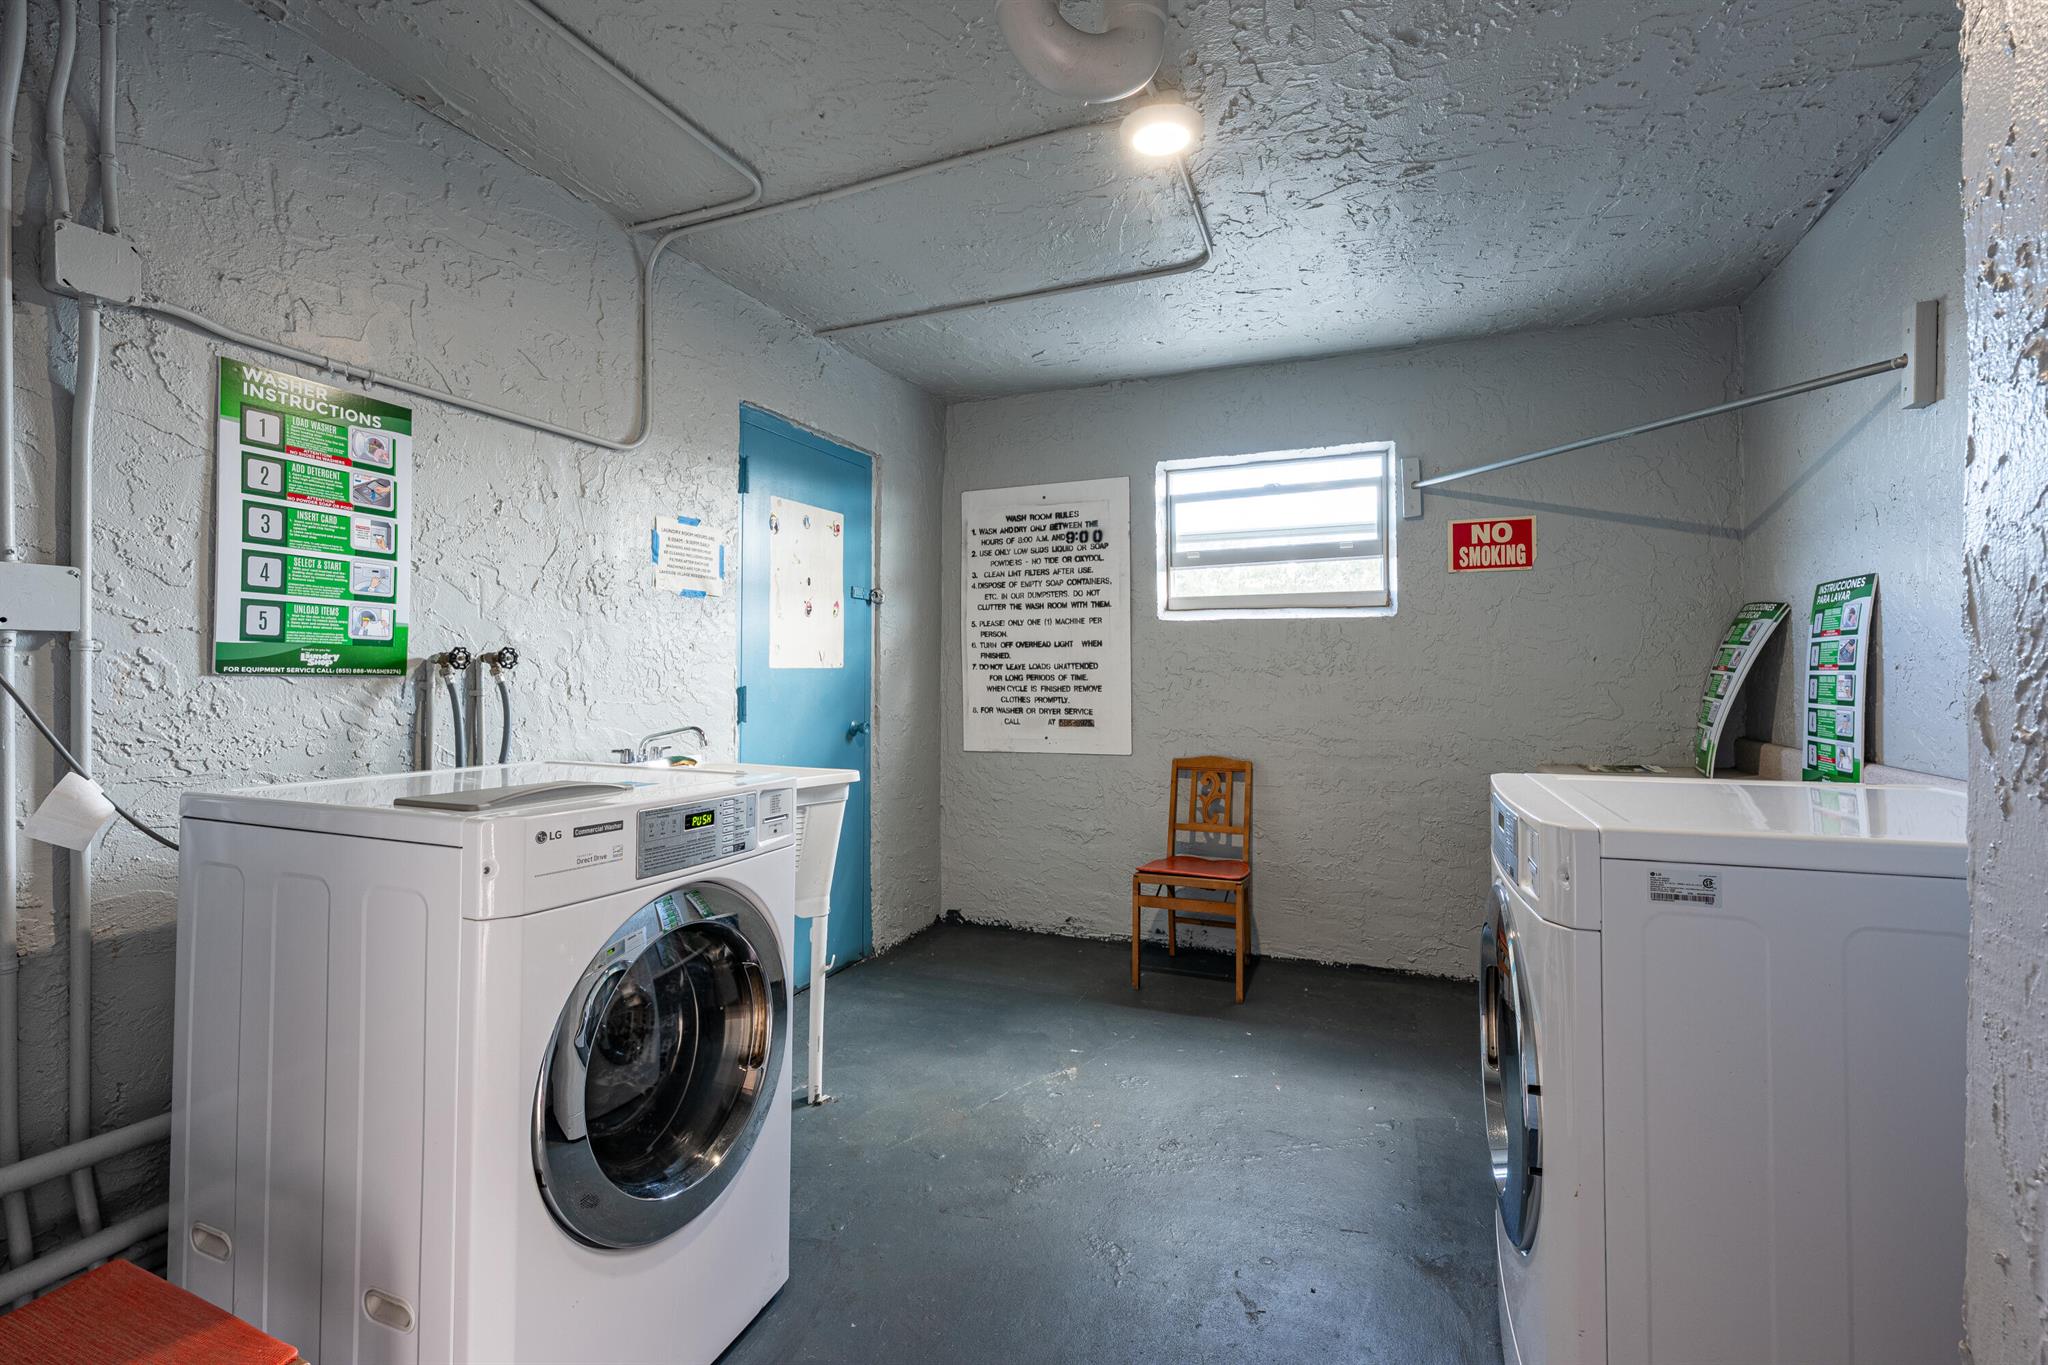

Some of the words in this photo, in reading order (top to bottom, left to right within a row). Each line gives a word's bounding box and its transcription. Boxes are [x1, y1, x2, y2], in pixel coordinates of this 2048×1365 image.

[243, 366, 328, 400] WASHER
[243, 382, 382, 428] INSTRUCTIONS
[259, 418, 266, 437] 1
[292, 416, 309, 428] LOAD
[311, 421, 337, 434] WASHER
[260, 466, 269, 486] 2
[291, 463, 305, 474] ADD
[307, 465, 340, 480] DETERGENT
[297, 510, 319, 522] INSERT
[320, 514, 338, 525] CARD
[1006, 514, 1027, 522] WASH
[1029, 513, 1052, 521] ROOM
[1055, 511, 1079, 519] RULES
[261, 514, 270, 534] 3
[1000, 526, 1013, 534] AND
[1050, 521, 1083, 531] BETWEEN
[1085, 520, 1098, 528] THE
[981, 538, 1003, 546] HOURS
[1018, 536, 1033, 544] 8:00
[1052, 533, 1065, 541] AND
[1471, 522, 1513, 544] NO
[1031, 546, 1049, 554] SUDS
[1052, 545, 1074, 553] LIQUID
[1090, 542, 1109, 550] SOAP
[1459, 543, 1526, 567] SMOKING
[293, 557, 315, 568] SELECT
[317, 560, 322, 569] &
[323, 561, 341, 571] START
[991, 559, 1022, 567] POWDERS
[1032, 557, 1042, 565] NO
[260, 562, 270, 582] 4
[978, 581, 1006, 589] DISPOSE
[1045, 579, 1064, 587] SOAP
[1818, 577, 1866, 594] INSTRUCCIONES
[1830, 590, 1851, 602] LAVAR
[293, 604, 319, 615] UNLOAD
[321, 606, 339, 617] ITEMS
[1025, 602, 1045, 610] WASH
[259, 610, 268, 631] 5
[1044, 618, 1052, 626] (1)
[1055, 617, 1085, 625] MACHINE
[1054, 662, 1099, 670] UNATTENDED
[1034, 696, 1070, 704] PROMPTLY.
[1039, 707, 1061, 715] DRYER
[691, 813, 712, 826] PUSH
[575, 824, 604, 836] Commercial
[604, 822, 622, 831] Washer
[576, 856, 593, 865] Direct
